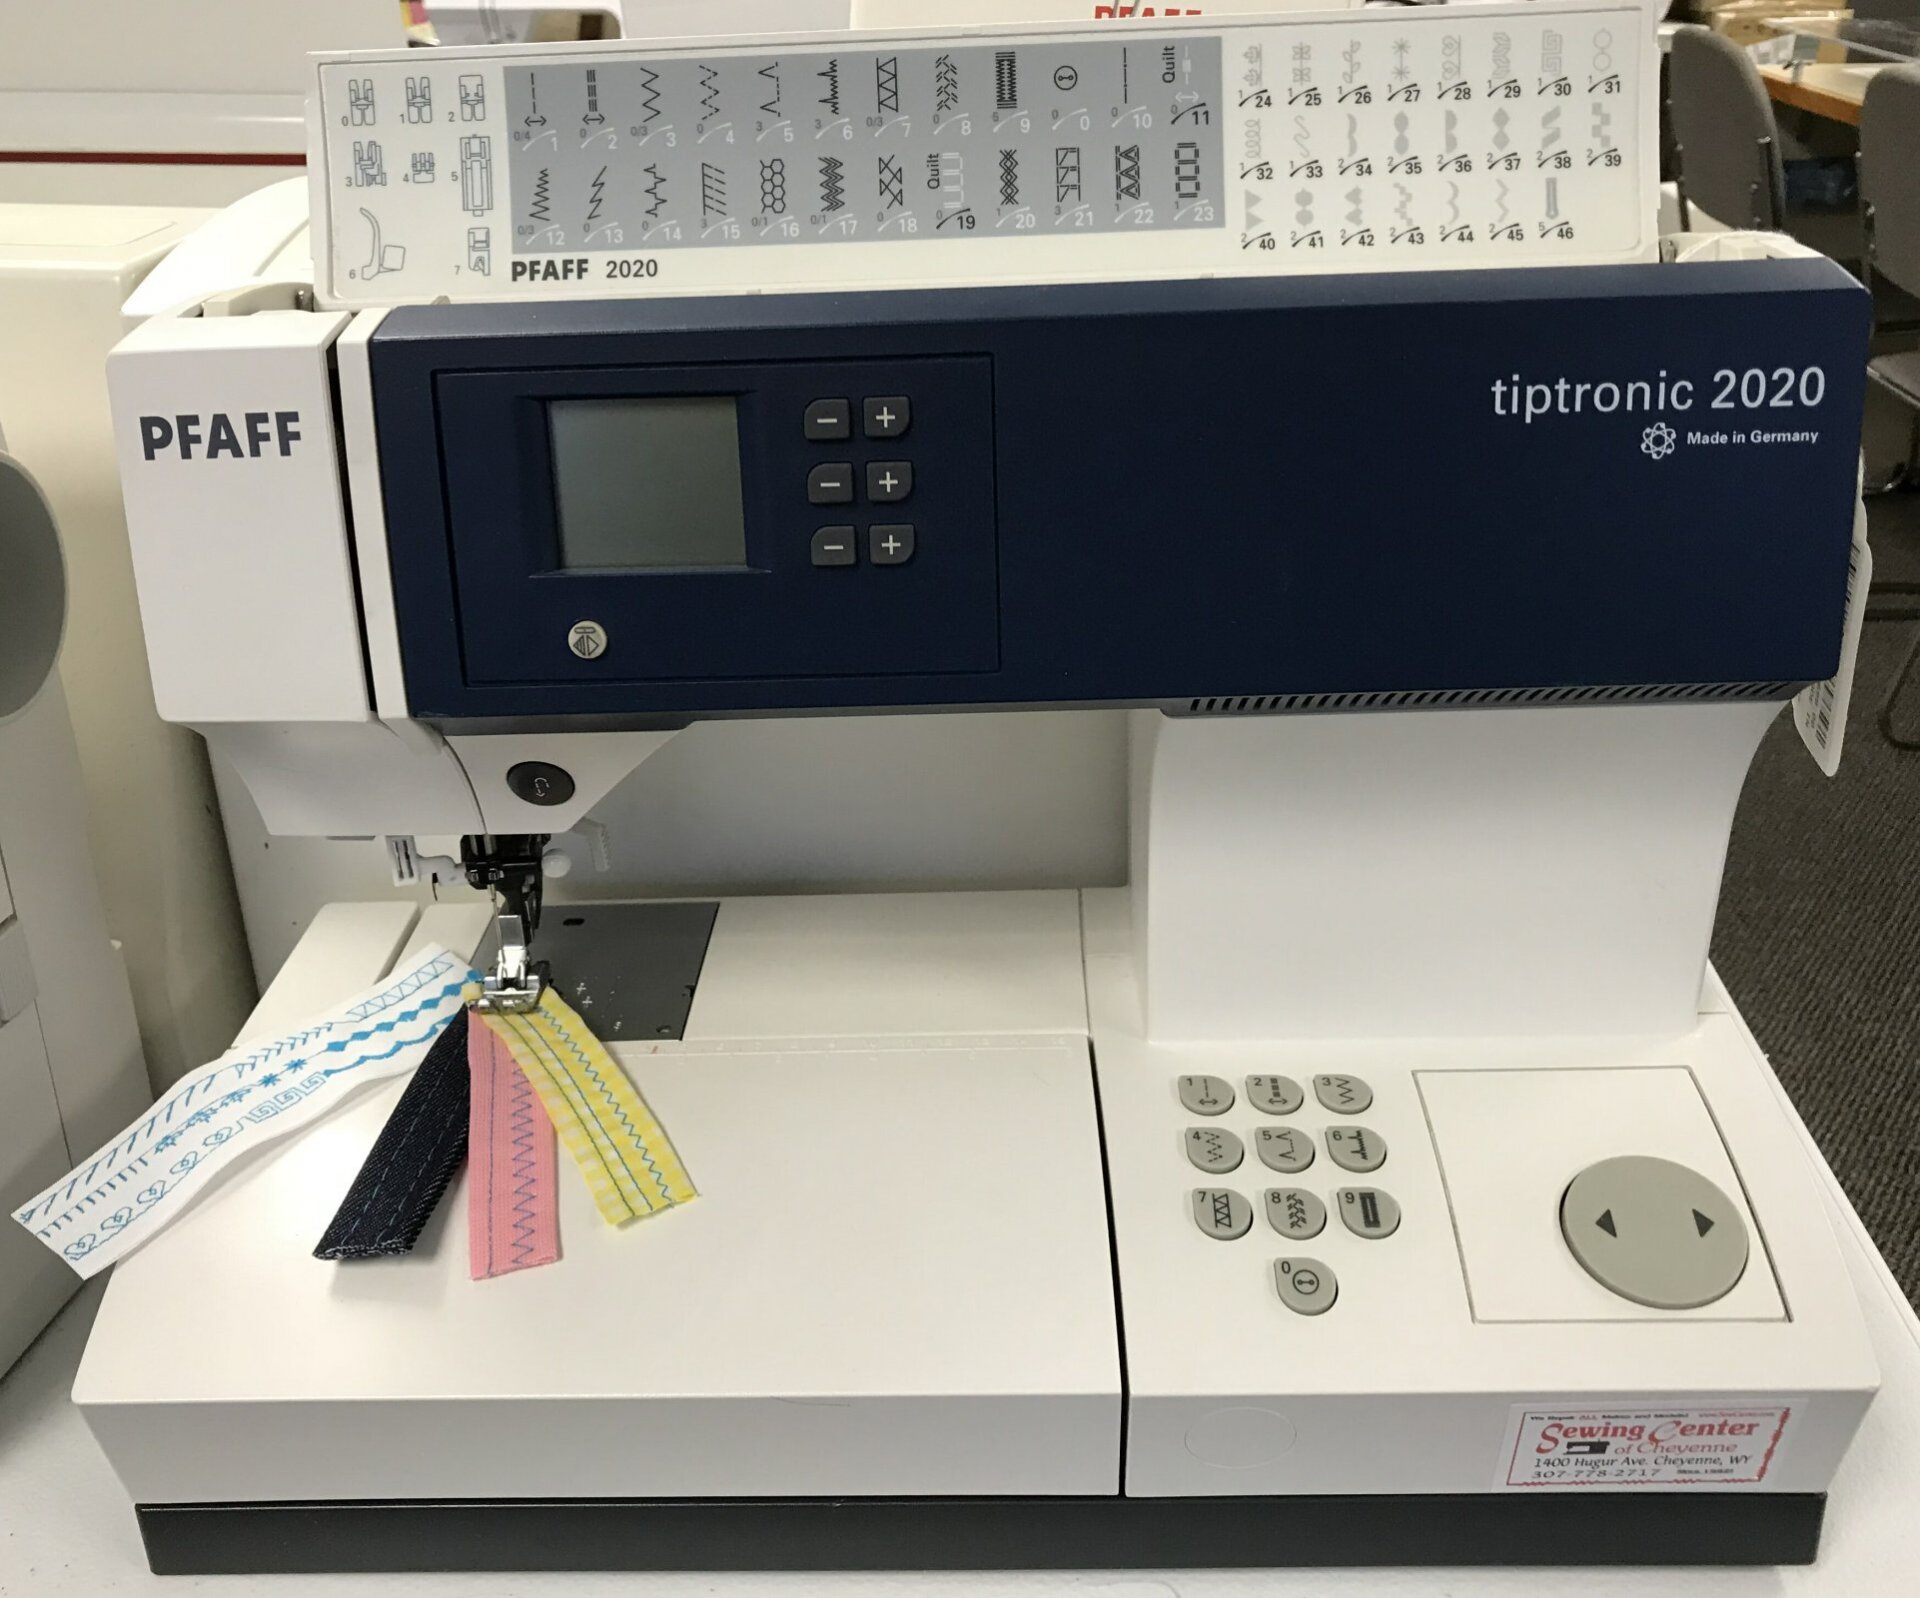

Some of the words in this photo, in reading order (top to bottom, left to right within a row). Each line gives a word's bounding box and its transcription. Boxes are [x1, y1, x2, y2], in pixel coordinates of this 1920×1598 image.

[1162, 46, 1175, 83] Quilt
[1454, 87, 1471, 100] 28
[1504, 85, 1521, 98] 29
[1554, 83, 1572, 96] 30
[1605, 81, 1621, 94] 31
[1256, 96, 1272, 108] 24
[1305, 93, 1322, 106] 25
[1355, 92, 1372, 104] 26
[1404, 90, 1420, 102] 27
[341, 116, 348, 126] 0
[400, 114, 405, 123] 1
[448, 112, 455, 122] 2
[1080, 116, 1090, 130] 0
[1133, 113, 1152, 128] 10
[1192, 110, 1209, 125] 11
[902, 122, 911, 137] 7
[961, 120, 971, 135] 8
[1020, 118, 1030, 132] 9
[726, 130, 734, 144] 4
[784, 128, 793, 142] 5
[843, 125, 853, 139] 6
[552, 137, 557, 151] 1
[608, 135, 617, 149] 2
[666, 132, 676, 147] 3
[1455, 160, 1472, 172] 36
[1505, 159, 1520, 171] 37
[1554, 156, 1571, 168] 38
[1605, 154, 1621, 166] 39
[927, 153, 940, 189] Quilt
[1256, 168, 1273, 180] 32
[1306, 165, 1323, 178] 33
[1356, 164, 1372, 176] 34
[1405, 162, 1422, 174] 35
[346, 177, 352, 187] 3
[403, 174, 409, 182] 4
[451, 172, 458, 181] 5
[1075, 212, 1093, 226] 21
[1135, 209, 1153, 223] 22
[1194, 207, 1214, 221] 23
[900, 218, 917, 232] 18
[957, 215, 975, 230] 19
[1016, 214, 1035, 228] 20
[663, 227, 682, 241] 14
[722, 225, 740, 239] 15
[781, 223, 799, 237] 16
[840, 221, 857, 235] 17
[1557, 227, 1574, 239] 46
[547, 232, 565, 245] 12
[605, 229, 623, 243] 13
[1359, 234, 1374, 247] 42
[1408, 232, 1424, 245] 43
[1458, 230, 1474, 242] 44
[1507, 229, 1524, 241] 45
[1260, 238, 1275, 250] 40
[1309, 236, 1324, 248] 41
[349, 269, 356, 279] 6
[455, 266, 460, 275] 7
[512, 258, 589, 282] PFAFF
[606, 259, 658, 278] 2020
[1491, 369, 1694, 424] tiptronic
[1710, 366, 1826, 409] 2020
[139, 411, 301, 461] PFAFF
[1687, 431, 1728, 445] Made
[1732, 431, 1745, 444] in
[1750, 430, 1819, 443] Germany
[1187, 1078, 1193, 1086] 1
[1254, 1077, 1262, 1086] 2
[1322, 1077, 1331, 1086] 3
[1193, 1131, 1201, 1141] 4
[1262, 1130, 1272, 1141] 5
[1333, 1130, 1342, 1141] 6
[1198, 1191, 1206, 1202] 7
[1271, 1192, 1281, 1203] 8
[1345, 1192, 1355, 1204] 9
[1281, 1261, 1291, 1274] 0
[1536, 1422, 1646, 1454] Sewing
[1648, 1419, 1760, 1448] Center
[1614, 1444, 1633, 1455] of
[1637, 1442, 1738, 1455] Cheyenne
[1534, 1458, 1570, 1468] 1400
[1621, 1456, 1646, 1466] Ave.
[1654, 1455, 1722, 1468] Cheyenne,
[1730, 1455, 1753, 1464] WY
[1531, 1469, 1661, 1479] 307-778-2717
